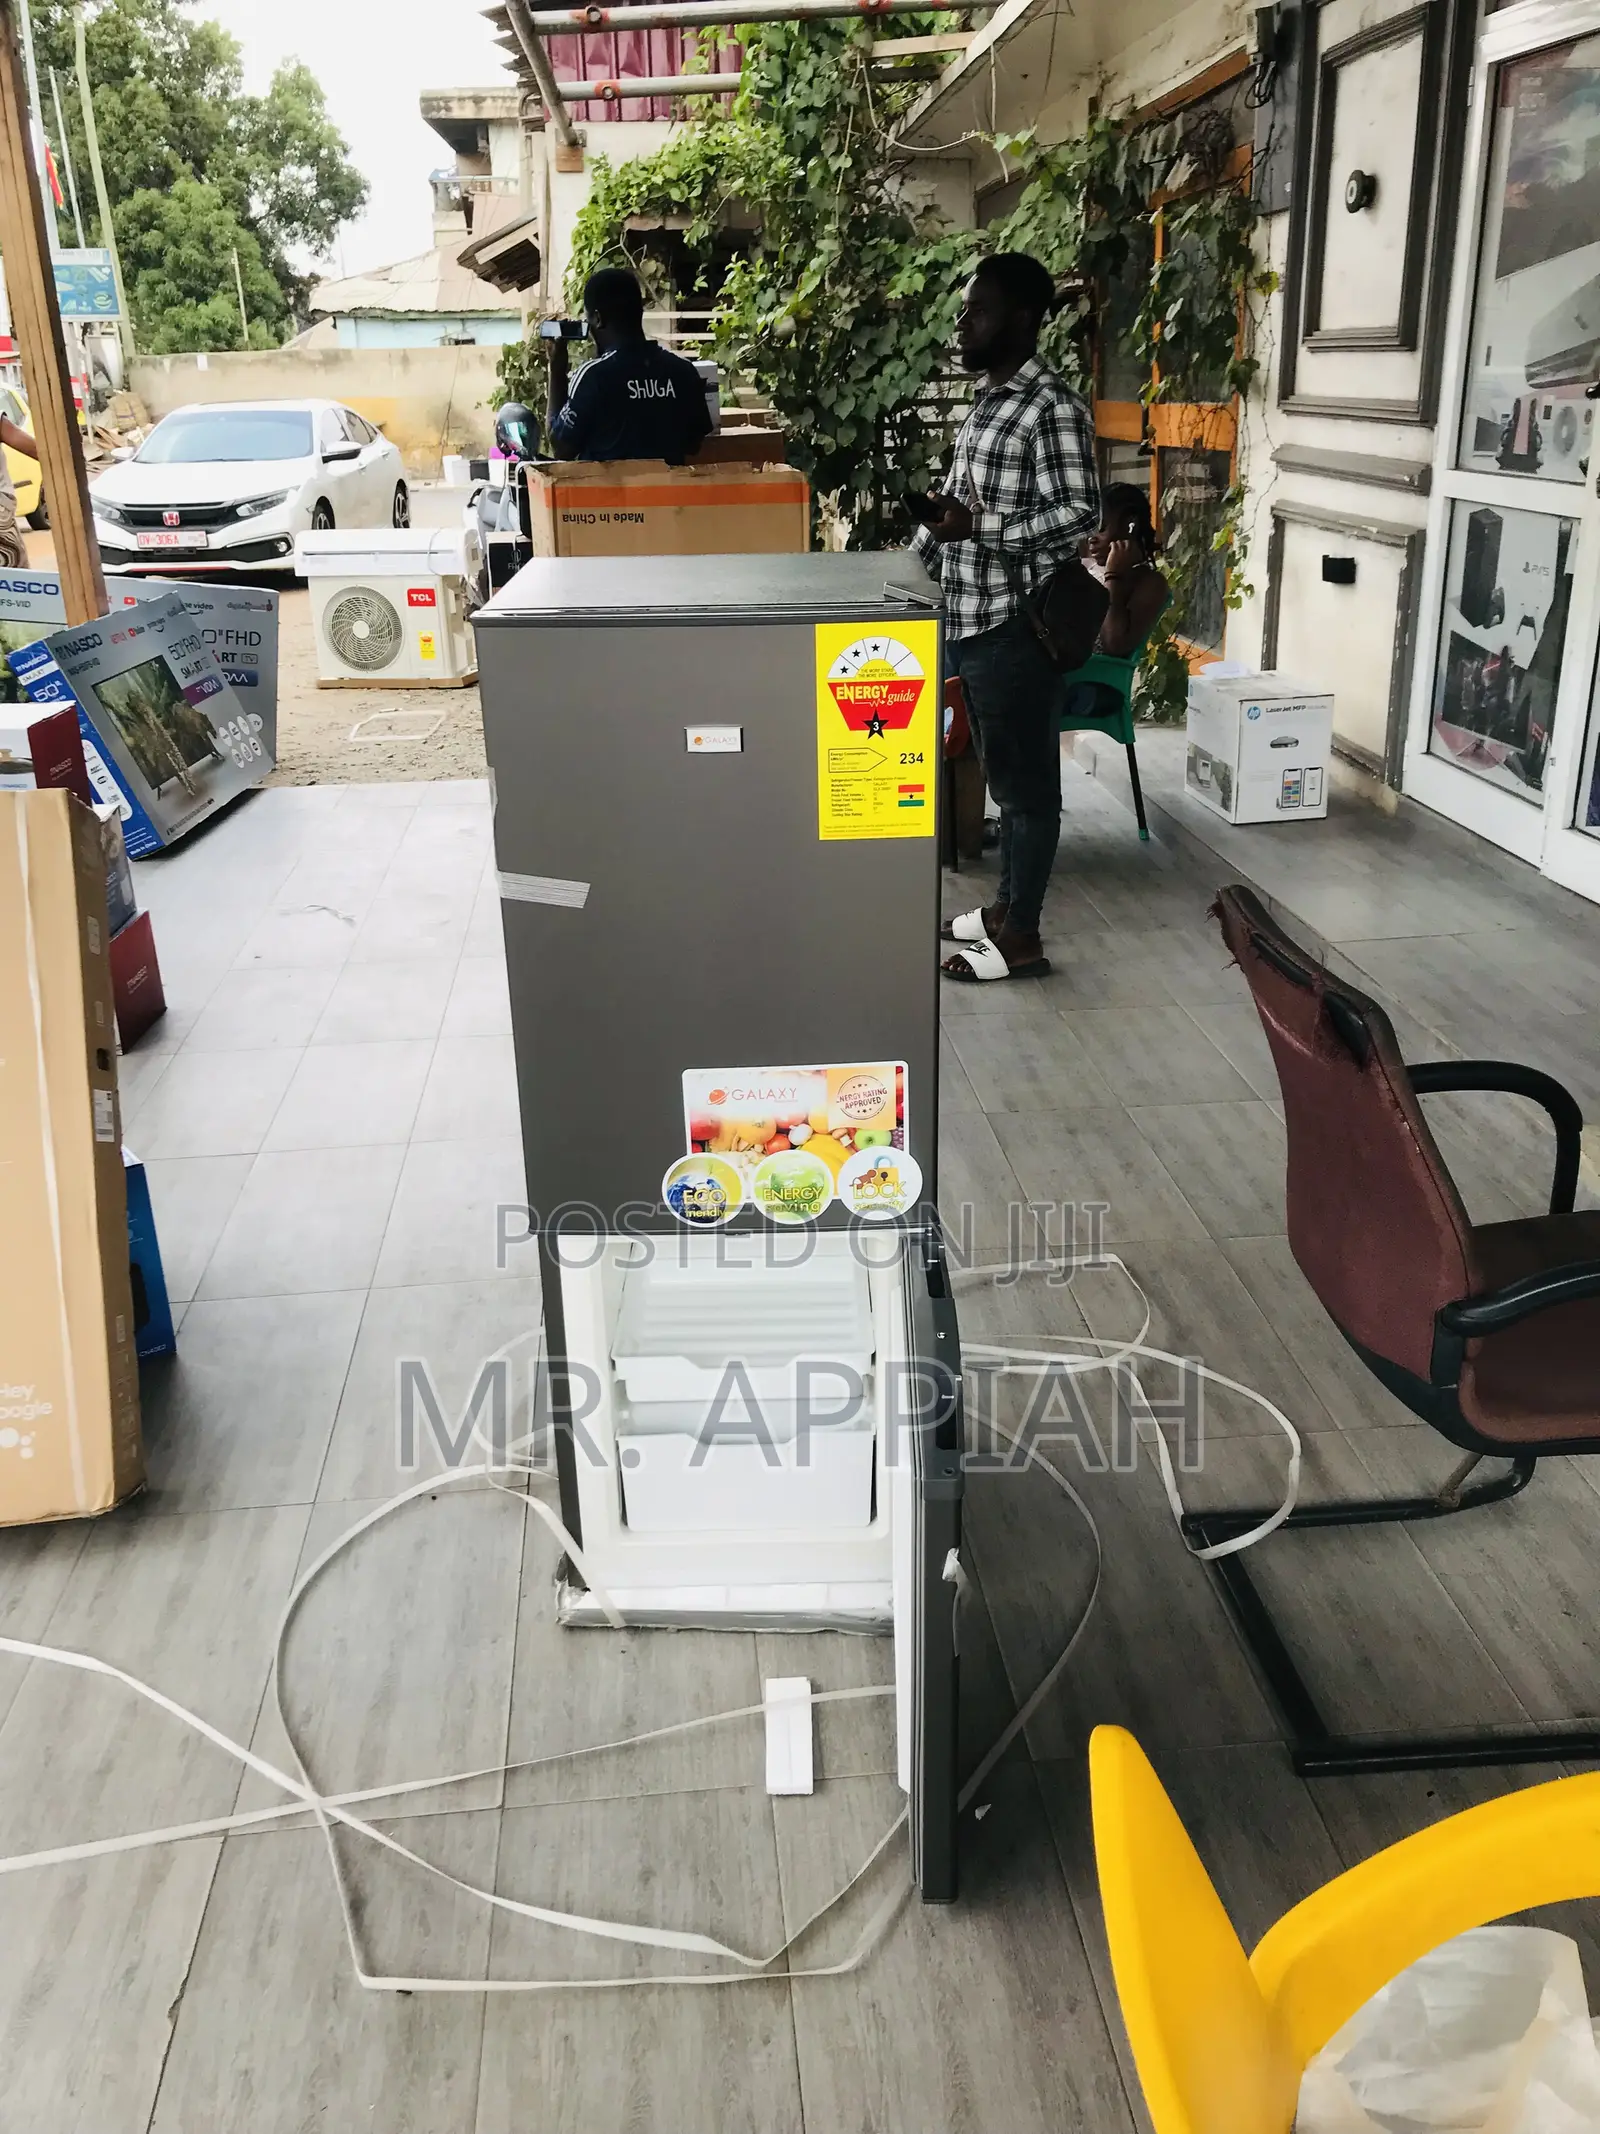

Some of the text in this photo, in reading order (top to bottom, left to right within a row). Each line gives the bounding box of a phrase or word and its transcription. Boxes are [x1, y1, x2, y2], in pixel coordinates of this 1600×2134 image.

[562, 513, 596, 524] China
[613, 512, 645, 523] Made
[1531, 564, 1550, 577] PS5
[0, 598, 31, 608] FS-VID
[410, 593, 432, 602] TCL
[194, 602, 214, 610] video
[64, 633, 103, 658] NASCO
[836, 683, 916, 706] ENERGY guide
[872, 721, 880, 731] 3
[899, 752, 924, 765] 234
[731, 1087, 798, 1101] GALAXY
[837, 1087, 888, 1104] NERGY RATING
[844, 1096, 882, 1110] APPROVED
[683, 1187, 727, 1204] ECO
[763, 1187, 823, 1201] ENERGY
[853, 1181, 907, 1200] LOCK
[765, 1200, 821, 1214] saving
[0, 1401, 53, 1420] oogle
